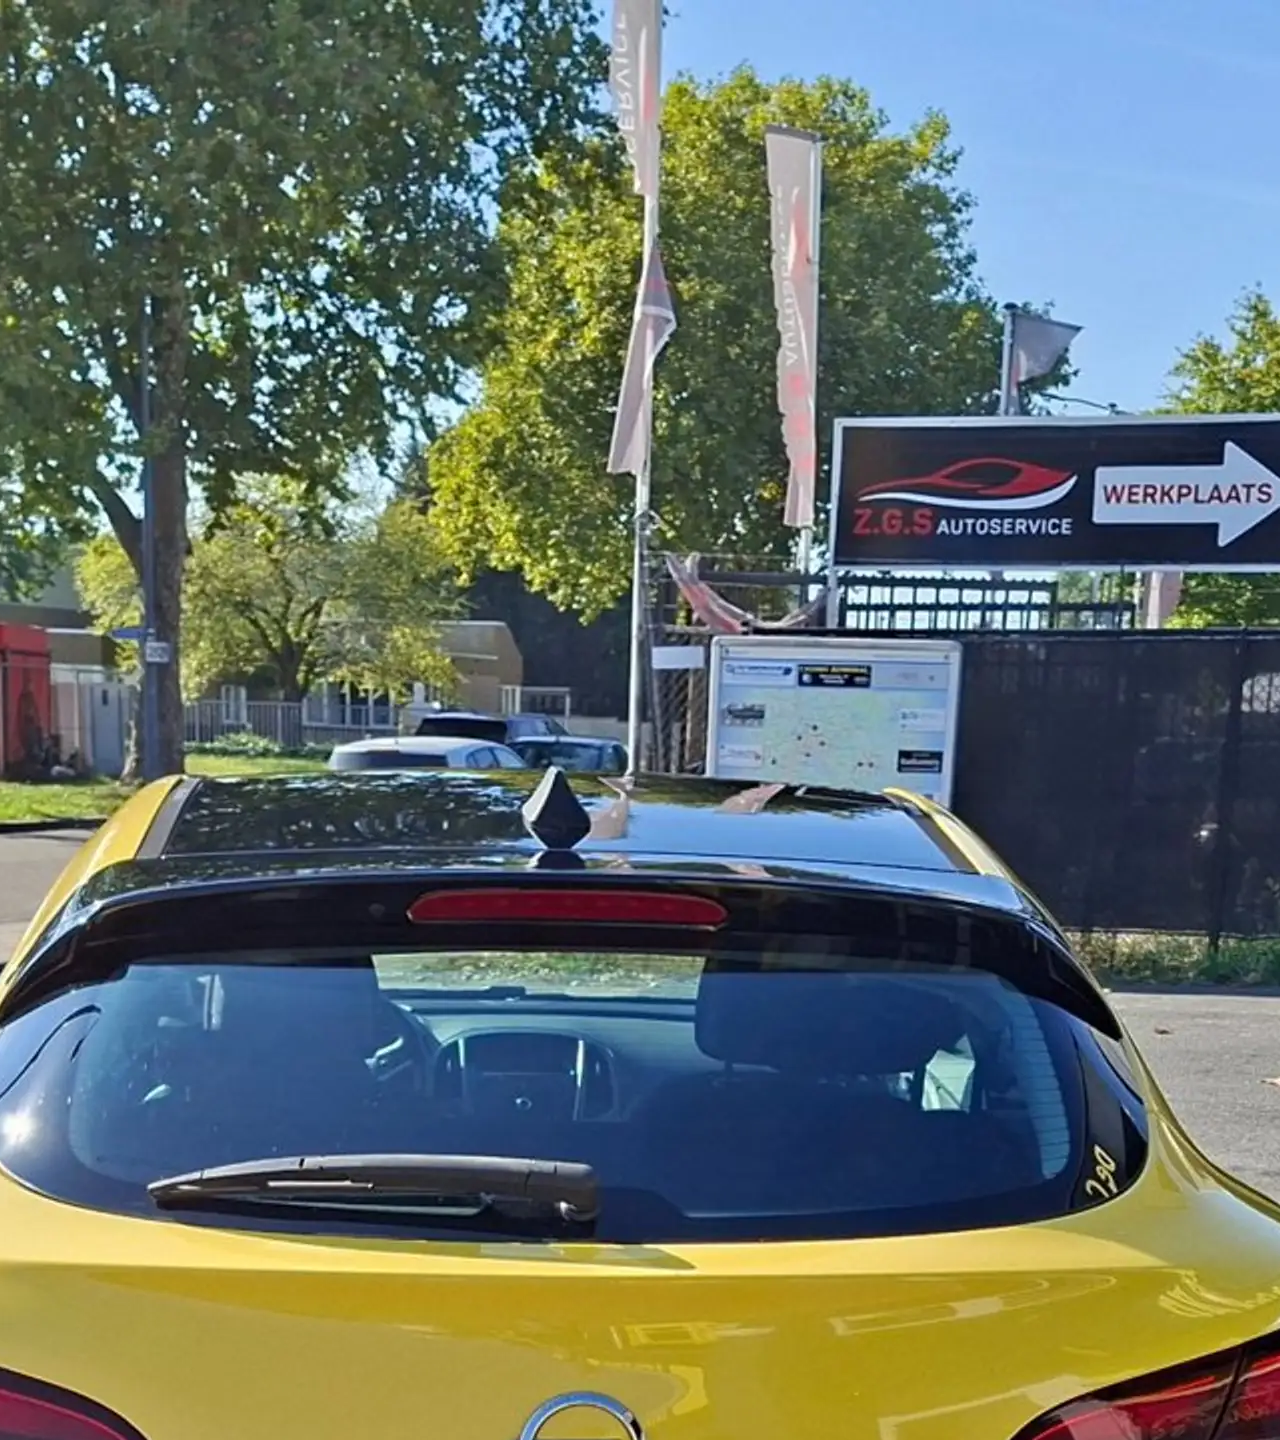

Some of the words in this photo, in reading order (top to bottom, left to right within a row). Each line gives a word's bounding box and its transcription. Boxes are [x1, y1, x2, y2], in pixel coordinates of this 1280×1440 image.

[1102, 481, 1274, 506] WERKPLAATS
[851, 508, 934, 537] Z.G.S
[936, 516, 1073, 537] AUTOSERVICE
